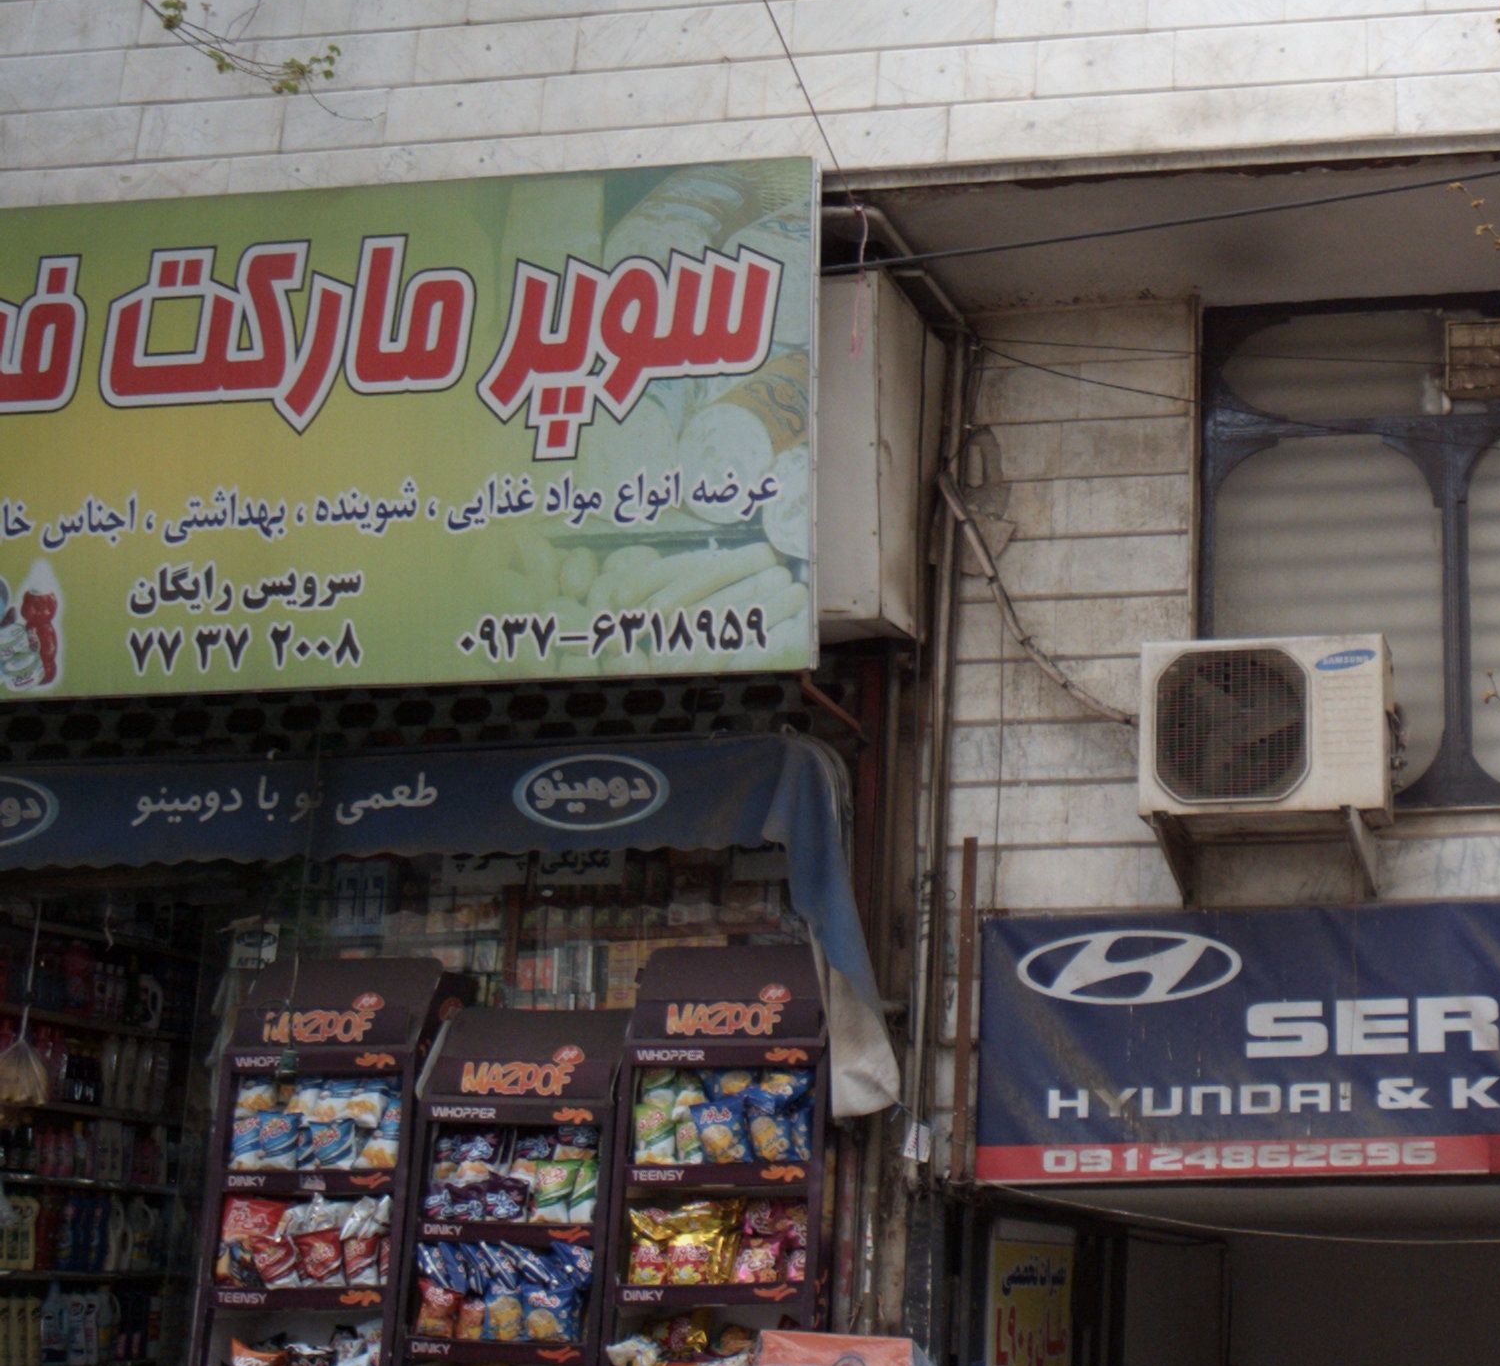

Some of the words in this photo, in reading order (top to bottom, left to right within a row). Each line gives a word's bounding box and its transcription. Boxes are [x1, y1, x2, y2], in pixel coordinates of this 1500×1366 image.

[103, 239, 471, 427] مارکت
[482, 251, 778, 455] سوپر
[315, 481, 417, 533] شوینده
[448, 476, 535, 530] غذایی
[546, 477, 602, 524] مواد
[614, 472, 681, 523] انواع
[692, 474, 778, 515] عرضه
[43, 497, 135, 549] اجناس
[164, 490, 285, 543] بهداشتی
[130, 566, 233, 614] رایگان
[243, 572, 362, 609] سرویس
[130, 631, 182, 672] ۷۷
[196, 628, 249, 670] ۳۷
[271, 623, 361, 667] ۲۰۰۸
[1321, 654, 1370, 666] SAMSUNG
[131, 785, 243, 827] دومینو
[257, 775, 280, 822] با
[290, 780, 326, 822] نو
[336, 771, 439, 825] طعمی
[533, 769, 652, 813] دومینو
[636, 1049, 706, 1062] WHOPPER
[431, 1105, 497, 1120] WHOPPER
[1047, 1082, 1352, 1120] HYUNDAI
[1377, 1078, 1433, 1111] &
[632, 1169, 685, 1182] TEENSY
[1042, 1141, 1438, 1174] 09124862696
[227, 1175, 266, 1188] DINKY
[423, 1223, 463, 1236] DINKY
[217, 1292, 268, 1305] TEENSY
[622, 1289, 664, 1302] DINKY
[411, 1341, 451, 1355] DINKY
